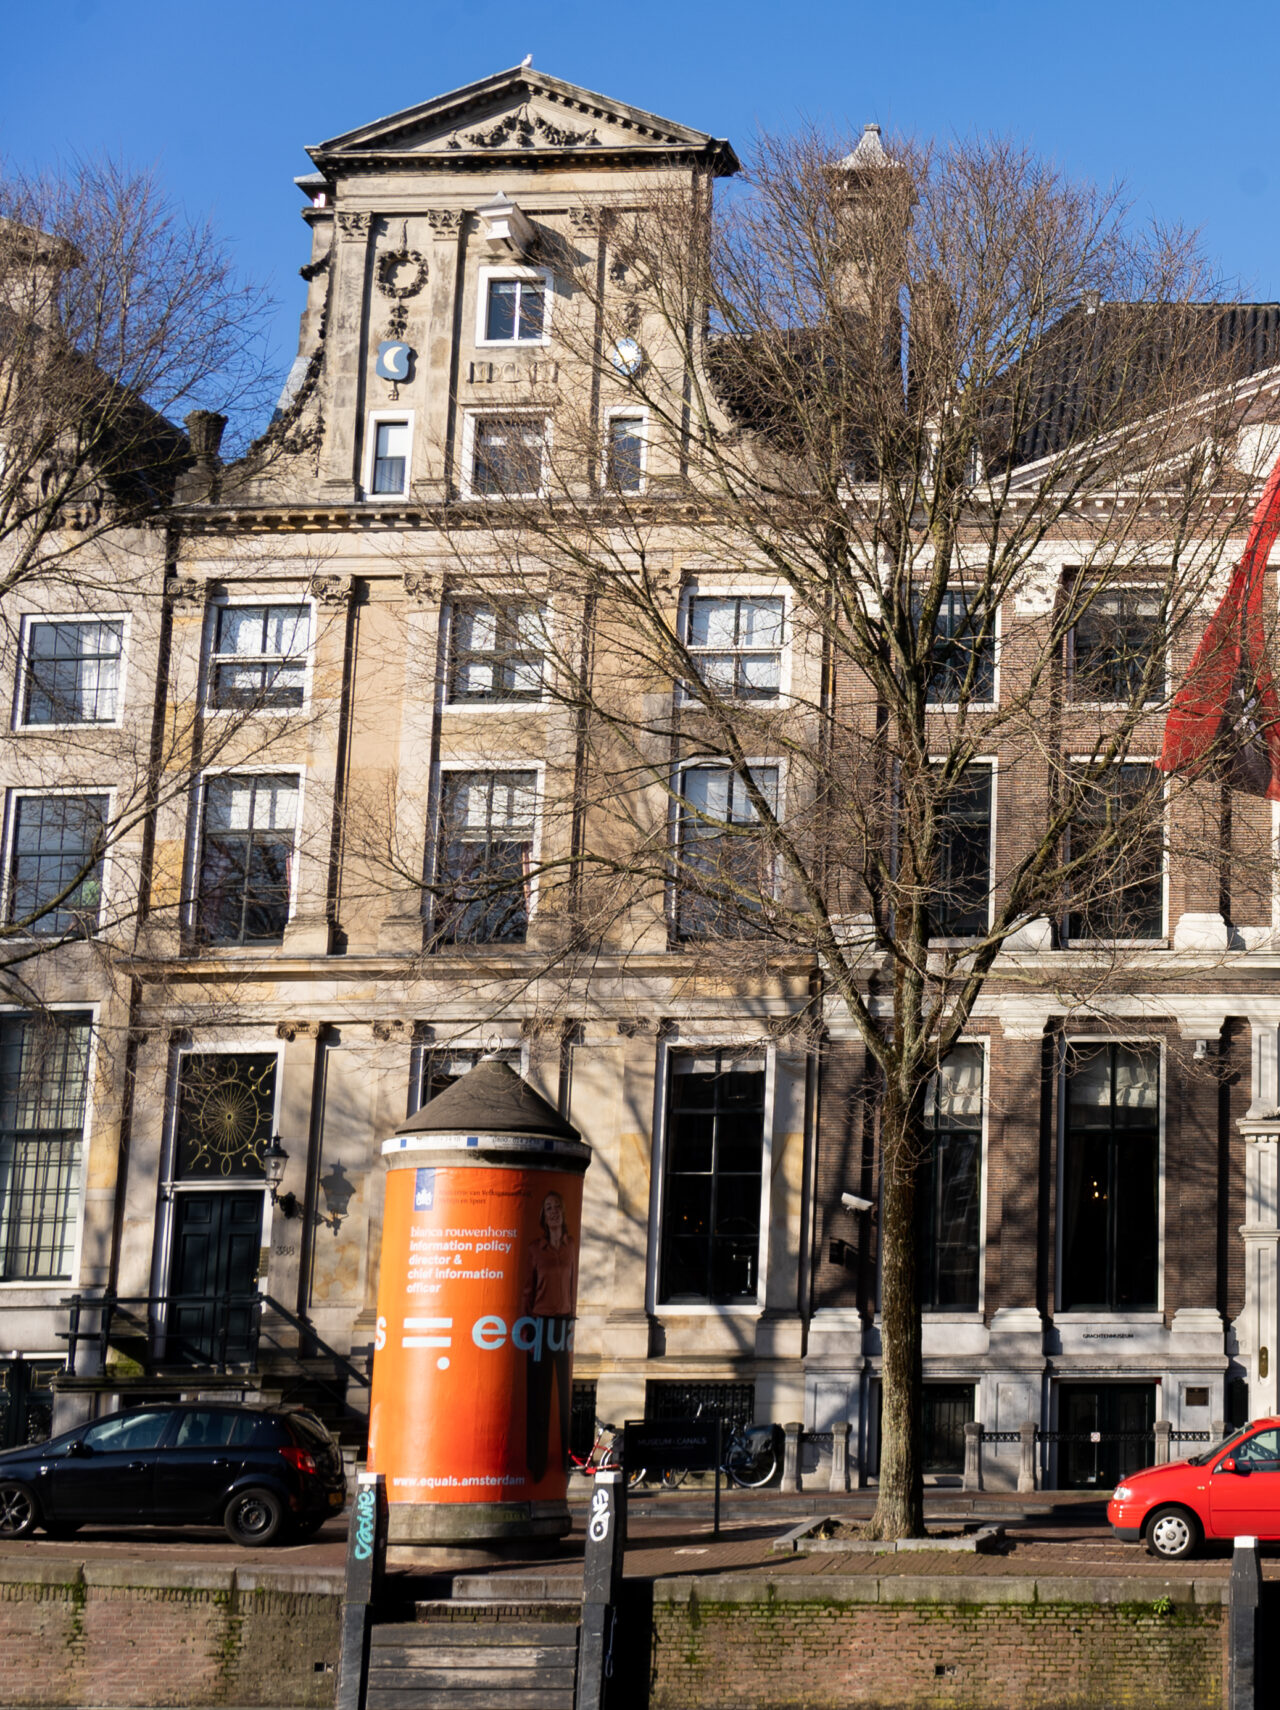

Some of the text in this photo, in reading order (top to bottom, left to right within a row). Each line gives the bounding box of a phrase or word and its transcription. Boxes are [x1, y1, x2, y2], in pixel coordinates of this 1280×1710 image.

[410, 1226, 518, 1238] bianca rouwenhorst
[409, 1240, 512, 1253] information policy
[408, 1254, 462, 1265] director &
[407, 1267, 504, 1279] chief information
[406, 1282, 441, 1293] officer
[393, 1475, 525, 1488] www.equals.amsterdam
